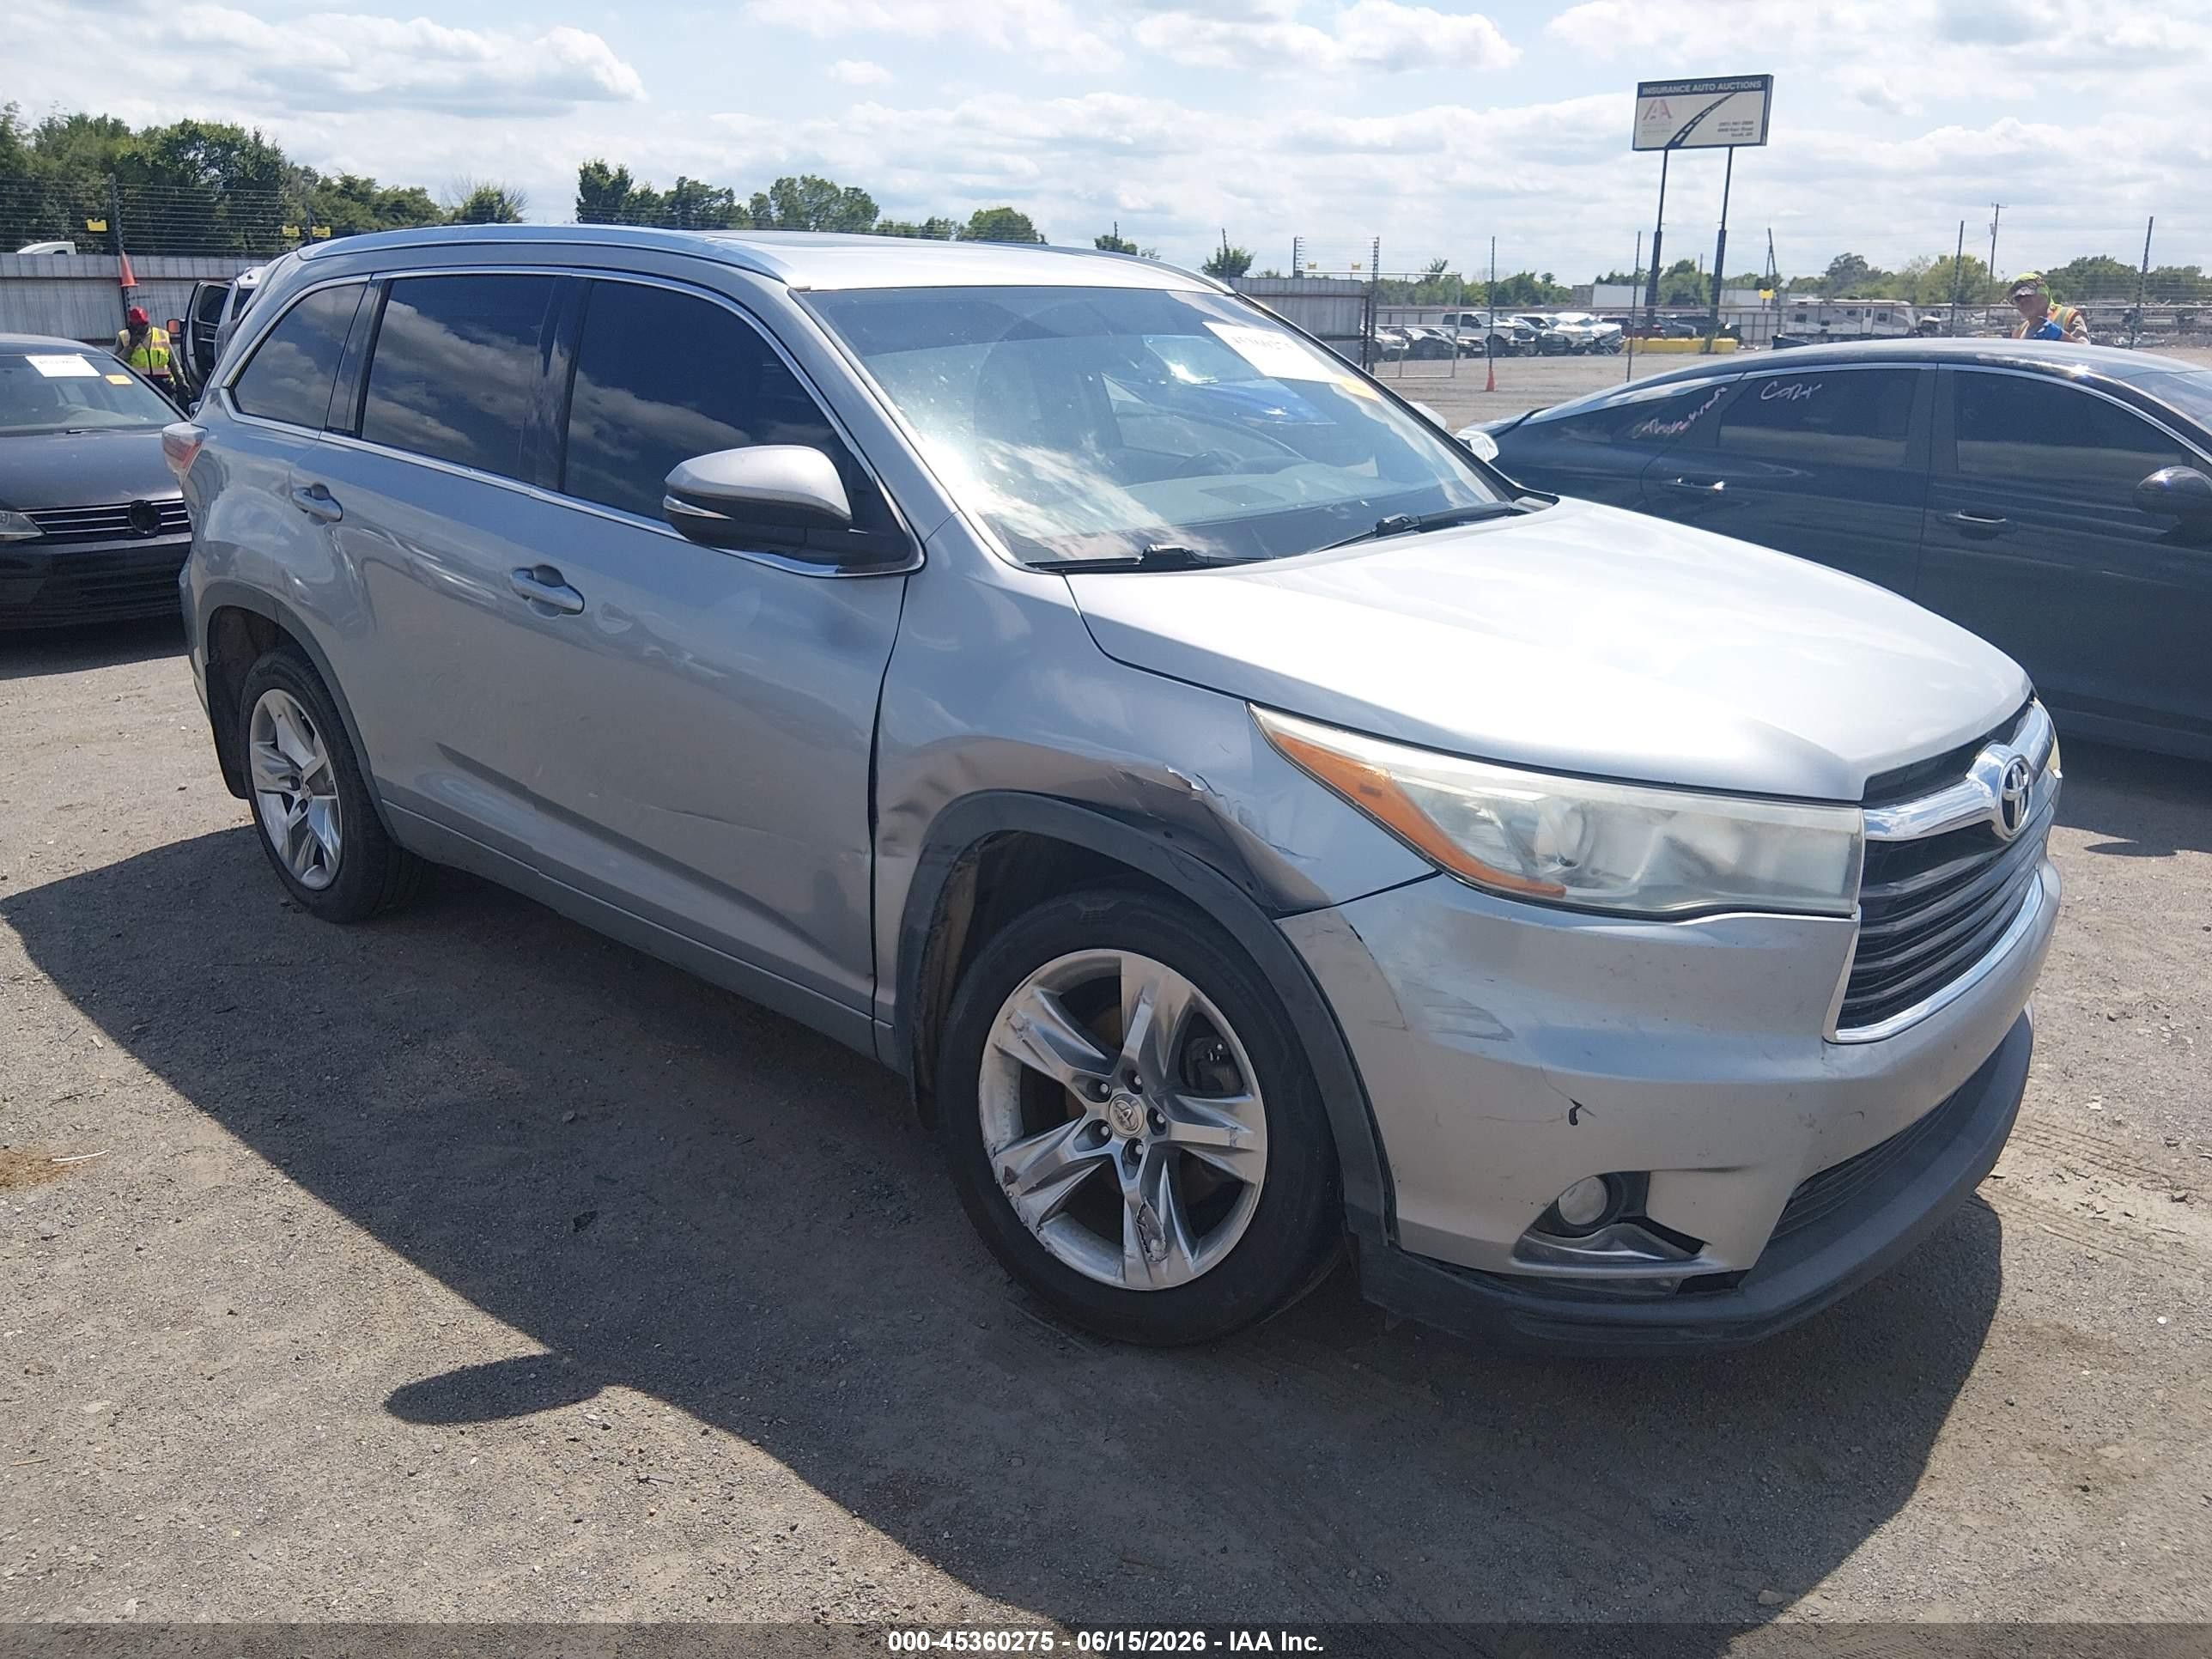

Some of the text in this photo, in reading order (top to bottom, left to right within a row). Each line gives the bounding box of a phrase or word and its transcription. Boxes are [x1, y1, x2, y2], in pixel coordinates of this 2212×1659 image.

[1642, 81, 1761, 95] INSURANCE AUTO AUCTIONS
